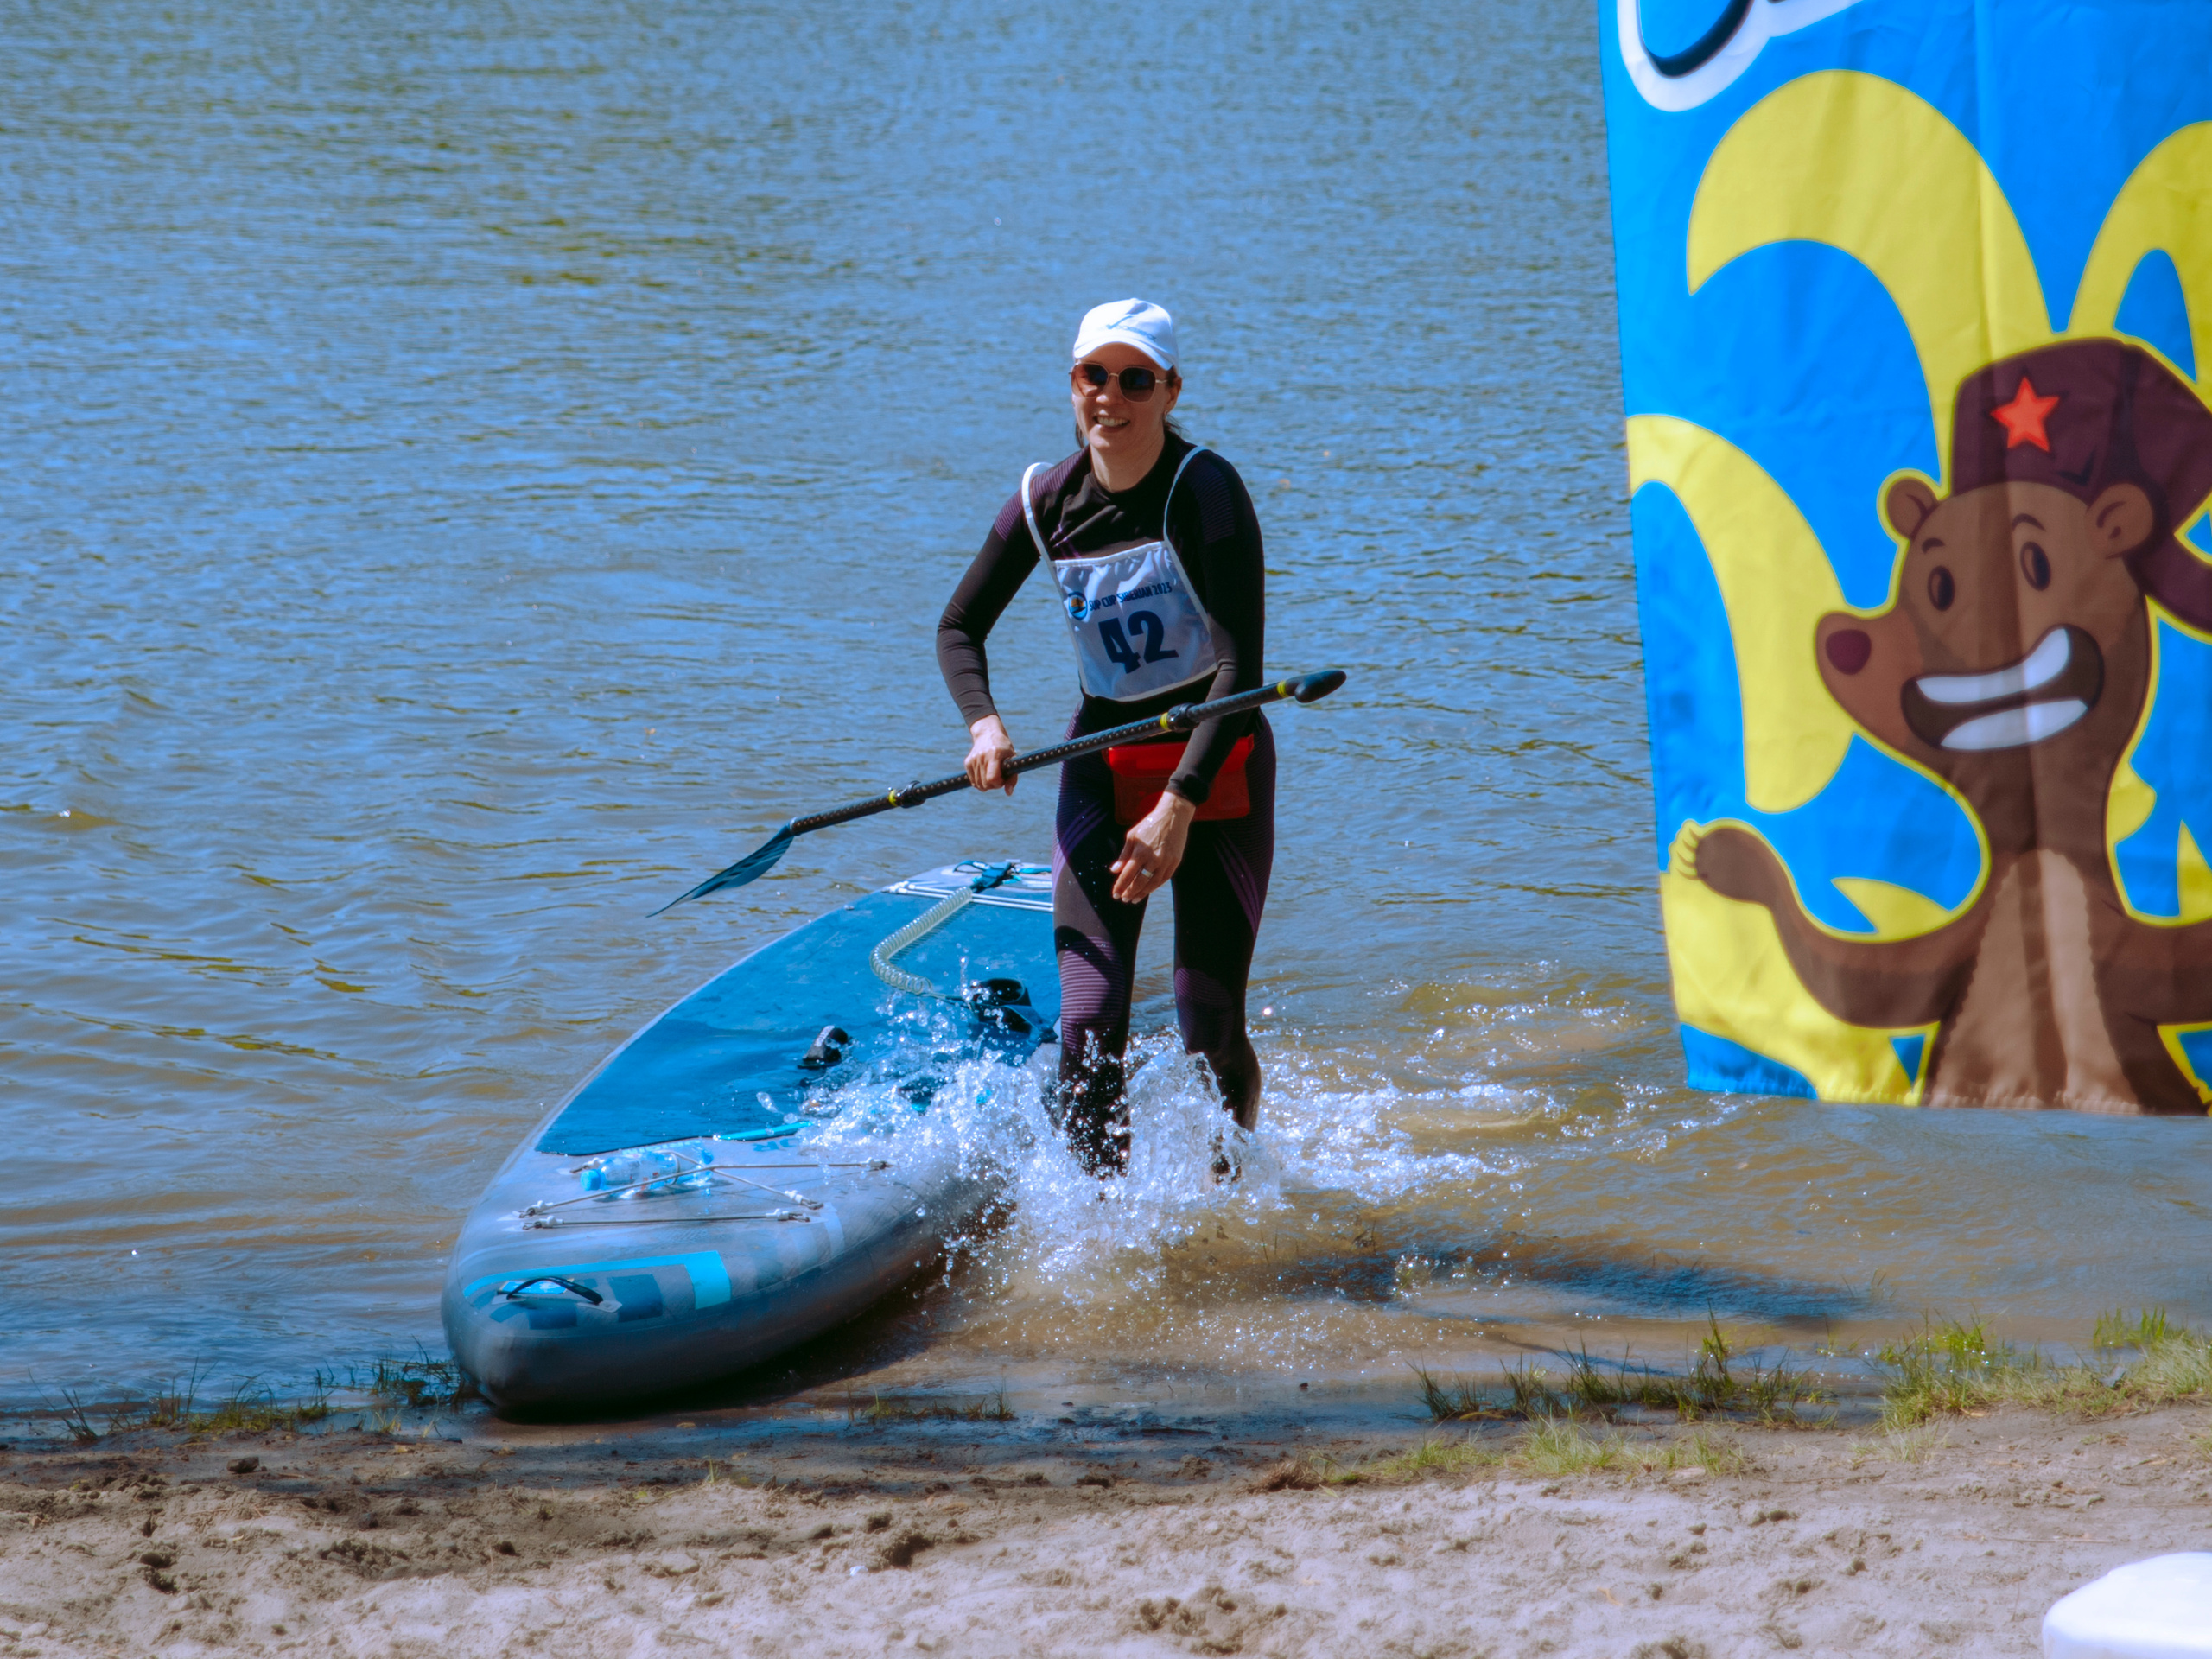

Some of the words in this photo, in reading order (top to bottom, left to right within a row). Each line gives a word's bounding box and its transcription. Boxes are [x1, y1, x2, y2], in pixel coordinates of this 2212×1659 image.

[1089, 599, 1102, 611] SUP
[1102, 594, 1117, 607] CUP
[1116, 586, 1153, 602] SIBERIAN
[1152, 582, 1173, 595] 2023
[1098, 610, 1179, 674] 42
